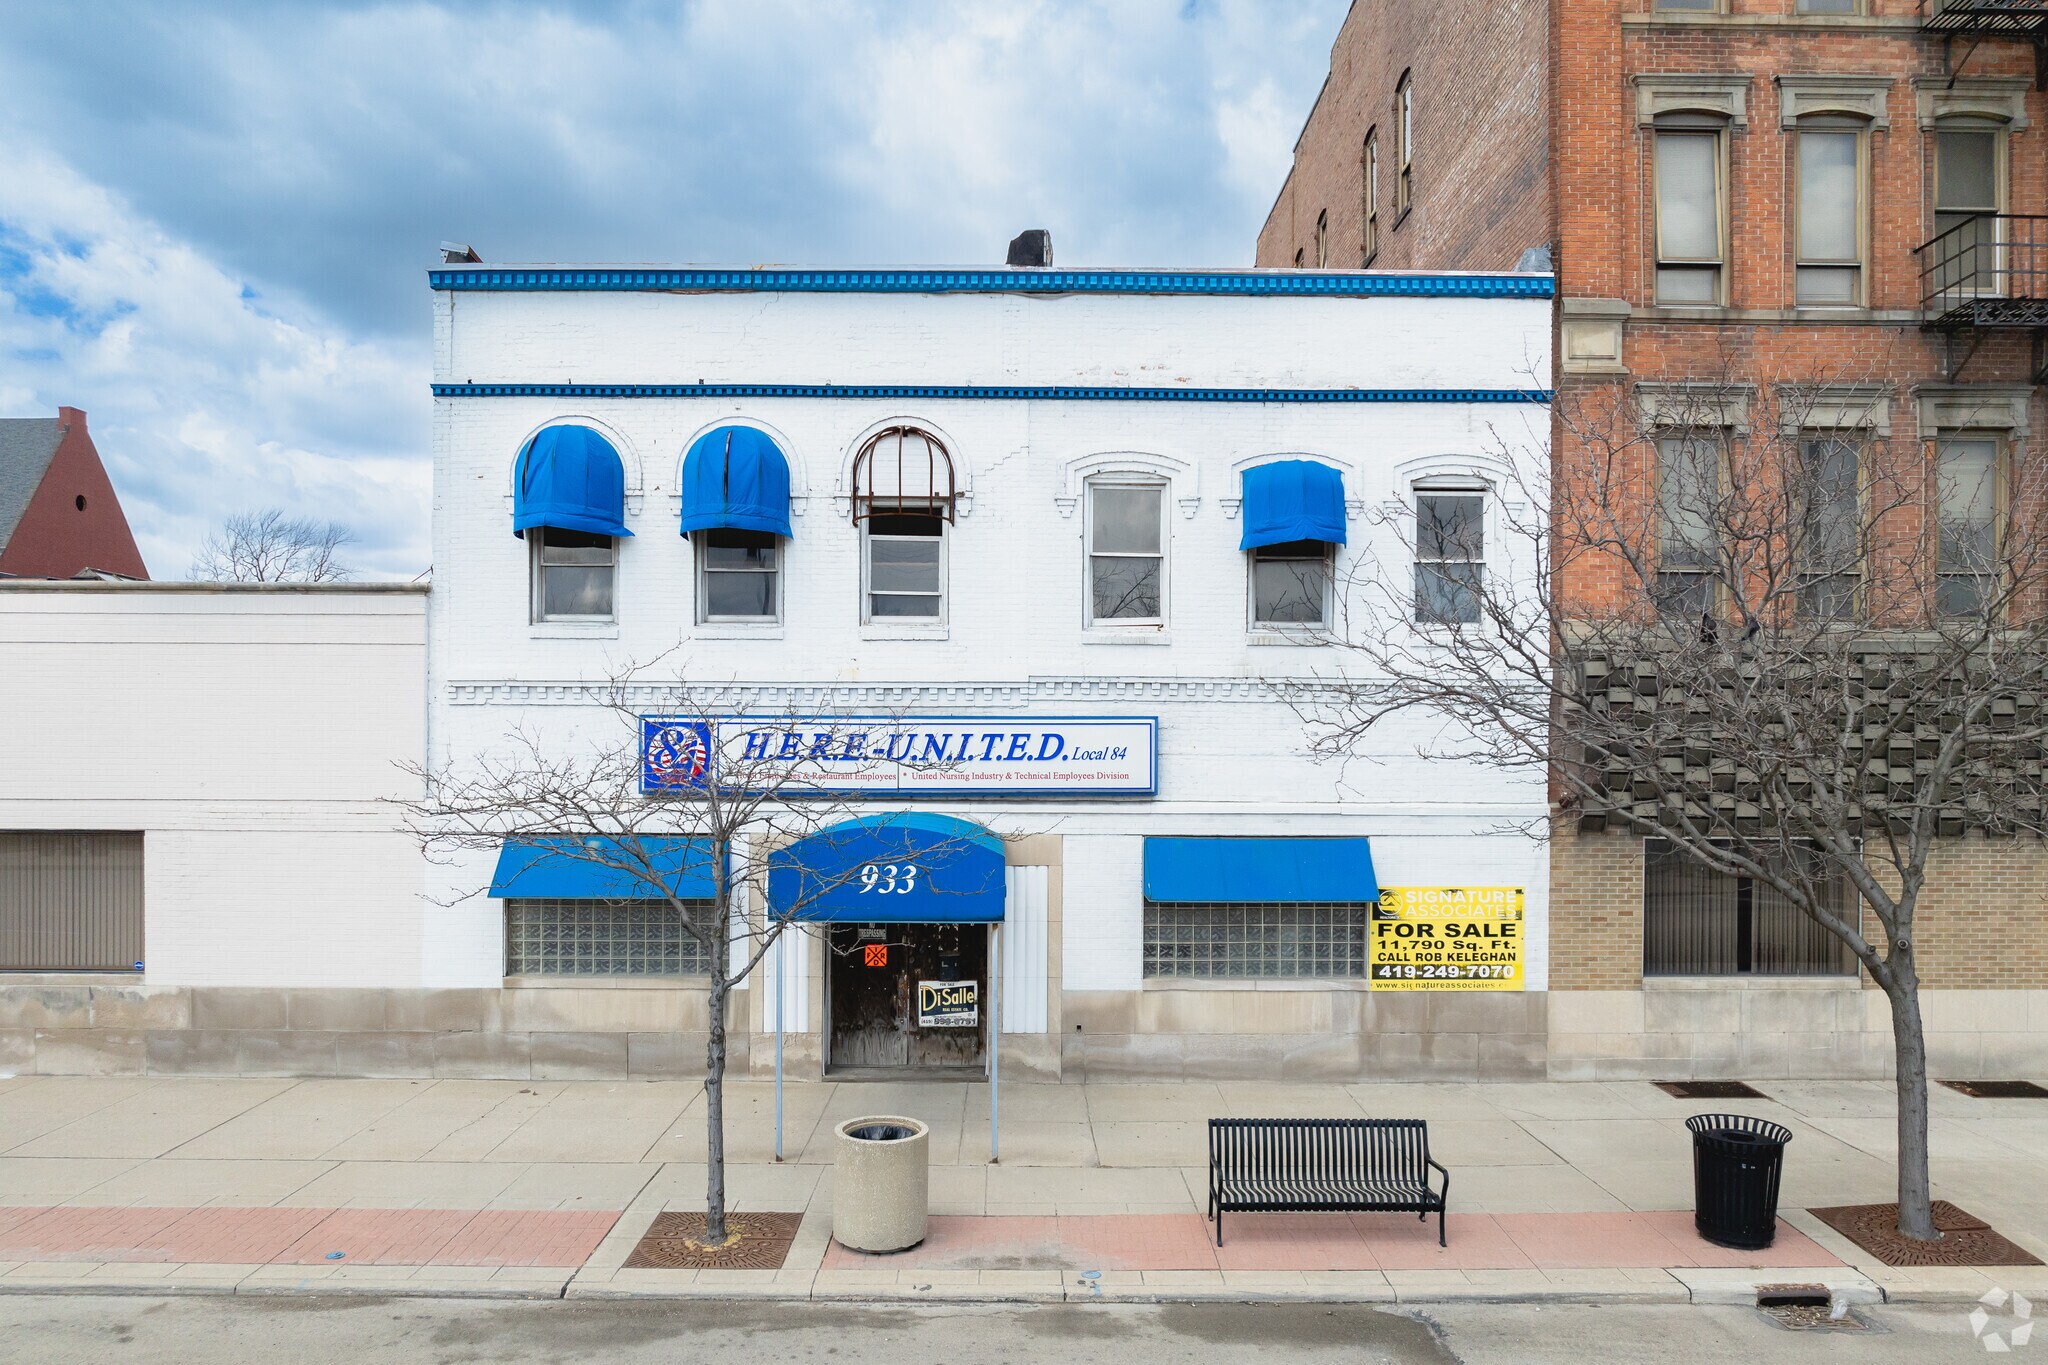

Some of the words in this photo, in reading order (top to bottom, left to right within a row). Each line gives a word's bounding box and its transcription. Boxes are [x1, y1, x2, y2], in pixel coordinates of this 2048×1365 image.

[1071, 746, 1109, 760] Local
[1110, 746, 1128, 760] 84
[803, 772, 810, 780] &
[812, 772, 853, 780] Restaurant
[855, 772, 896, 782] Employees
[911, 772, 936, 780] United
[940, 772, 970, 782] Nursing
[972, 772, 1004, 782] Industry
[1005, 772, 1012, 780] &
[1014, 771, 1051, 780] Technical
[1053, 771, 1095, 782] Employees
[1097, 771, 1130, 780] Division
[859, 864, 917, 894] 933
[1405, 890, 1517, 904] SIGNATURE
[1405, 904, 1517, 917] ASSOCIATES
[1378, 923, 1435, 938] FOR
[1444, 923, 1516, 938] SALE
[1377, 940, 1445, 951] 11,790
[1452, 940, 1484, 952] Sq.
[1491, 940, 1516, 950] Ft.
[1377, 952, 1411, 962] CALL
[1415, 952, 1442, 962] ROB
[1447, 952, 1516, 962] KELEGHAN
[1378, 965, 1516, 978] 419-249-7070
[920, 985, 975, 1012] DiSalle
